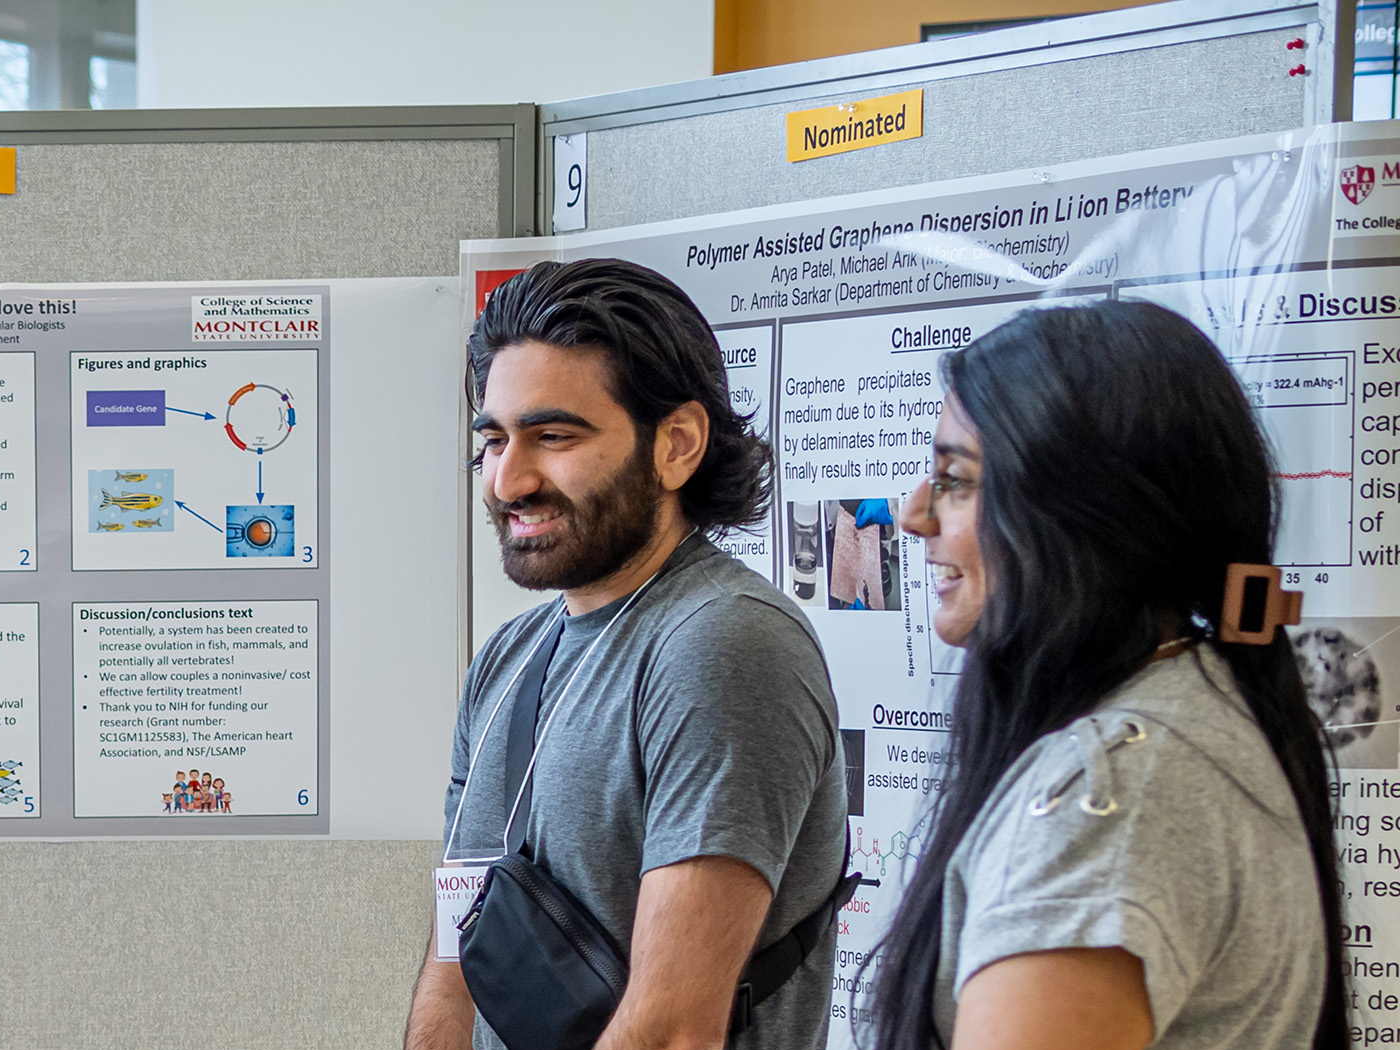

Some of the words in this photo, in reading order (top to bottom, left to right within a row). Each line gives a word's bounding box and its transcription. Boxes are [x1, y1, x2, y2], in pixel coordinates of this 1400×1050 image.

[804, 105, 906, 151] Nominated
[566, 163, 583, 208] 9
[687, 243, 750, 270] Polymer
[753, 228, 825, 259] Assisted
[1029, 200, 1049, 225] in
[1054, 195, 1074, 223] Li
[1077, 194, 1108, 219] ion
[1115, 184, 1194, 214] Battery
[1336, 219, 1358, 230] The
[770, 265, 798, 286] Arya
[802, 259, 836, 280] Patel,
[840, 250, 889, 275] Michael
[731, 294, 747, 312] Dr.
[750, 287, 788, 310] Amrita
[792, 284, 831, 306] Sarkar
[836, 278, 914, 306] (Department
[917, 273, 931, 293] of
[38, 300, 76, 314] this!
[200, 297, 247, 308] College
[250, 296, 263, 306] of
[266, 296, 313, 305] Science
[1300, 292, 1400, 317] Discus
[204, 307, 227, 316] and
[230, 306, 310, 316] Mathematics
[17, 320, 66, 332] Biologists
[194, 320, 319, 333] MONTCLAIR
[892, 324, 972, 349] Challenge
[78, 358, 123, 372] Figures
[127, 357, 150, 369] and
[154, 356, 207, 371] graphics
[785, 376, 846, 399] Graphene
[857, 370, 932, 395] precipitates
[1273, 378, 1300, 389] 322.4
[94, 405, 135, 413] Candidate
[136, 404, 157, 413] Gene
[784, 405, 832, 424] medium
[836, 402, 860, 421] due
[863, 402, 876, 420] to
[880, 400, 894, 418] its
[784, 434, 799, 455] by
[801, 431, 875, 451] delaminates
[878, 429, 907, 448] from
[911, 427, 931, 446] the
[785, 461, 818, 484] finally
[821, 459, 862, 479] results
[865, 459, 888, 477] into
[892, 461, 921, 480] poor
[1359, 511, 1384, 533] of
[20, 549, 30, 565] 2
[302, 546, 313, 563] 3
[910, 580, 921, 589] 100
[1286, 572, 1300, 584] 35
[1314, 572, 1329, 584] 40
[80, 607, 225, 621] Discussion/conclusions
[228, 608, 253, 618] text
[907, 635, 915, 677] Specific
[873, 704, 953, 728] Overcome
[192, 731, 211, 741] The
[213, 731, 263, 741] American
[265, 731, 293, 740] heart
[99, 747, 161, 758] Association,
[164, 747, 183, 757] and
[186, 746, 246, 758] NSF/LSAMP
[887, 744, 908, 762] We
[868, 771, 918, 790] assisted
[24, 796, 34, 813] 5
[298, 789, 309, 806] 6
